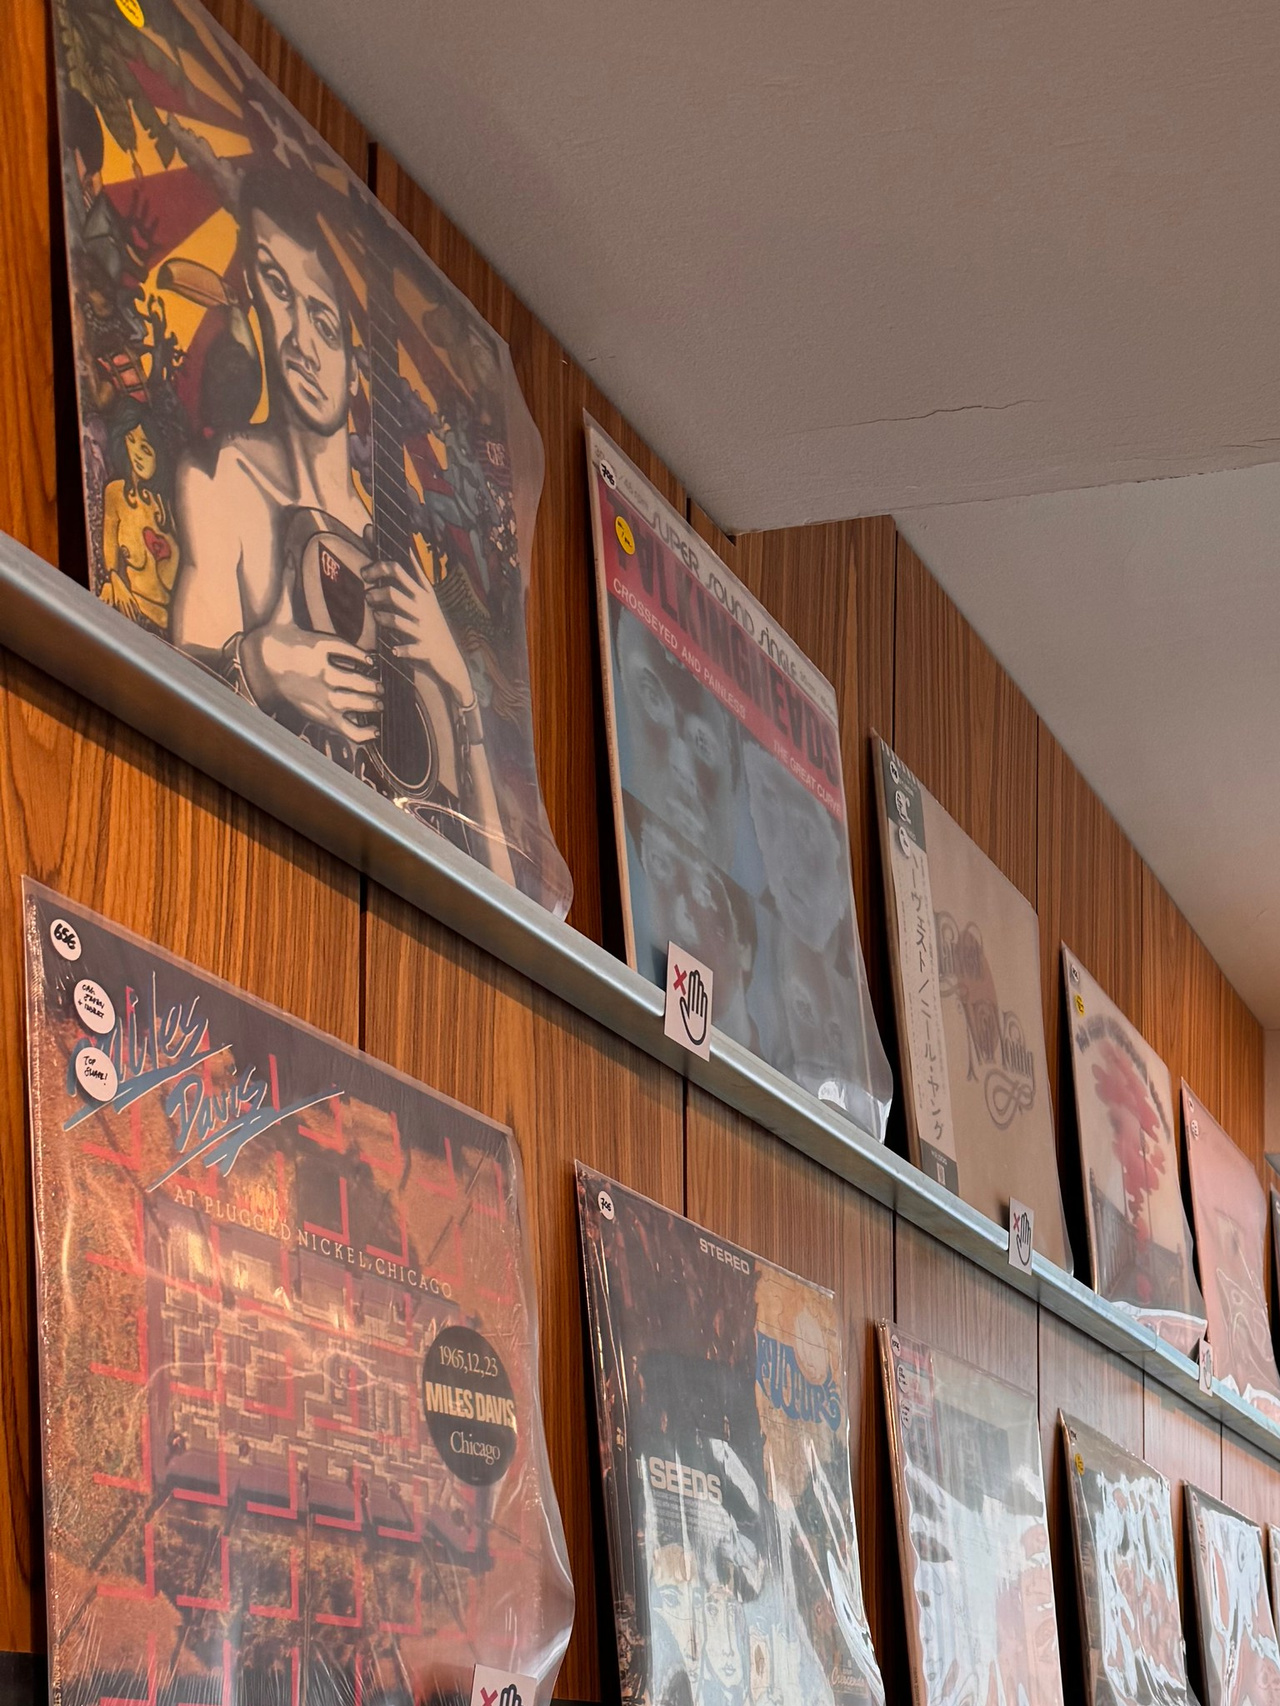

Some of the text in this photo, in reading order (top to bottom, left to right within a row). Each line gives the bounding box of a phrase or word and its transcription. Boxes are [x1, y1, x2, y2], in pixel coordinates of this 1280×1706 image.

[650, 511, 701, 579] SUPER
[613, 577, 679, 651] CROSSEYED
[681, 646, 702, 675] AND
[704, 668, 748, 721] PAINLESS
[773, 740, 843, 816] THE GREAT CURVE
[83, 1055, 97, 1066] TOP
[166, 1065, 269, 1153] Davis
[174, 1184, 197, 1209] AT
[205, 1193, 293, 1241] PLUGGED
[700, 1237, 750, 1275] STEREO
[439, 1344, 499, 1378] 1965,12,23
[425, 1381, 516, 1428] MILES DAVIS
[450, 1430, 501, 1466] Chicago
[648, 1456, 723, 1506] SEEDS
